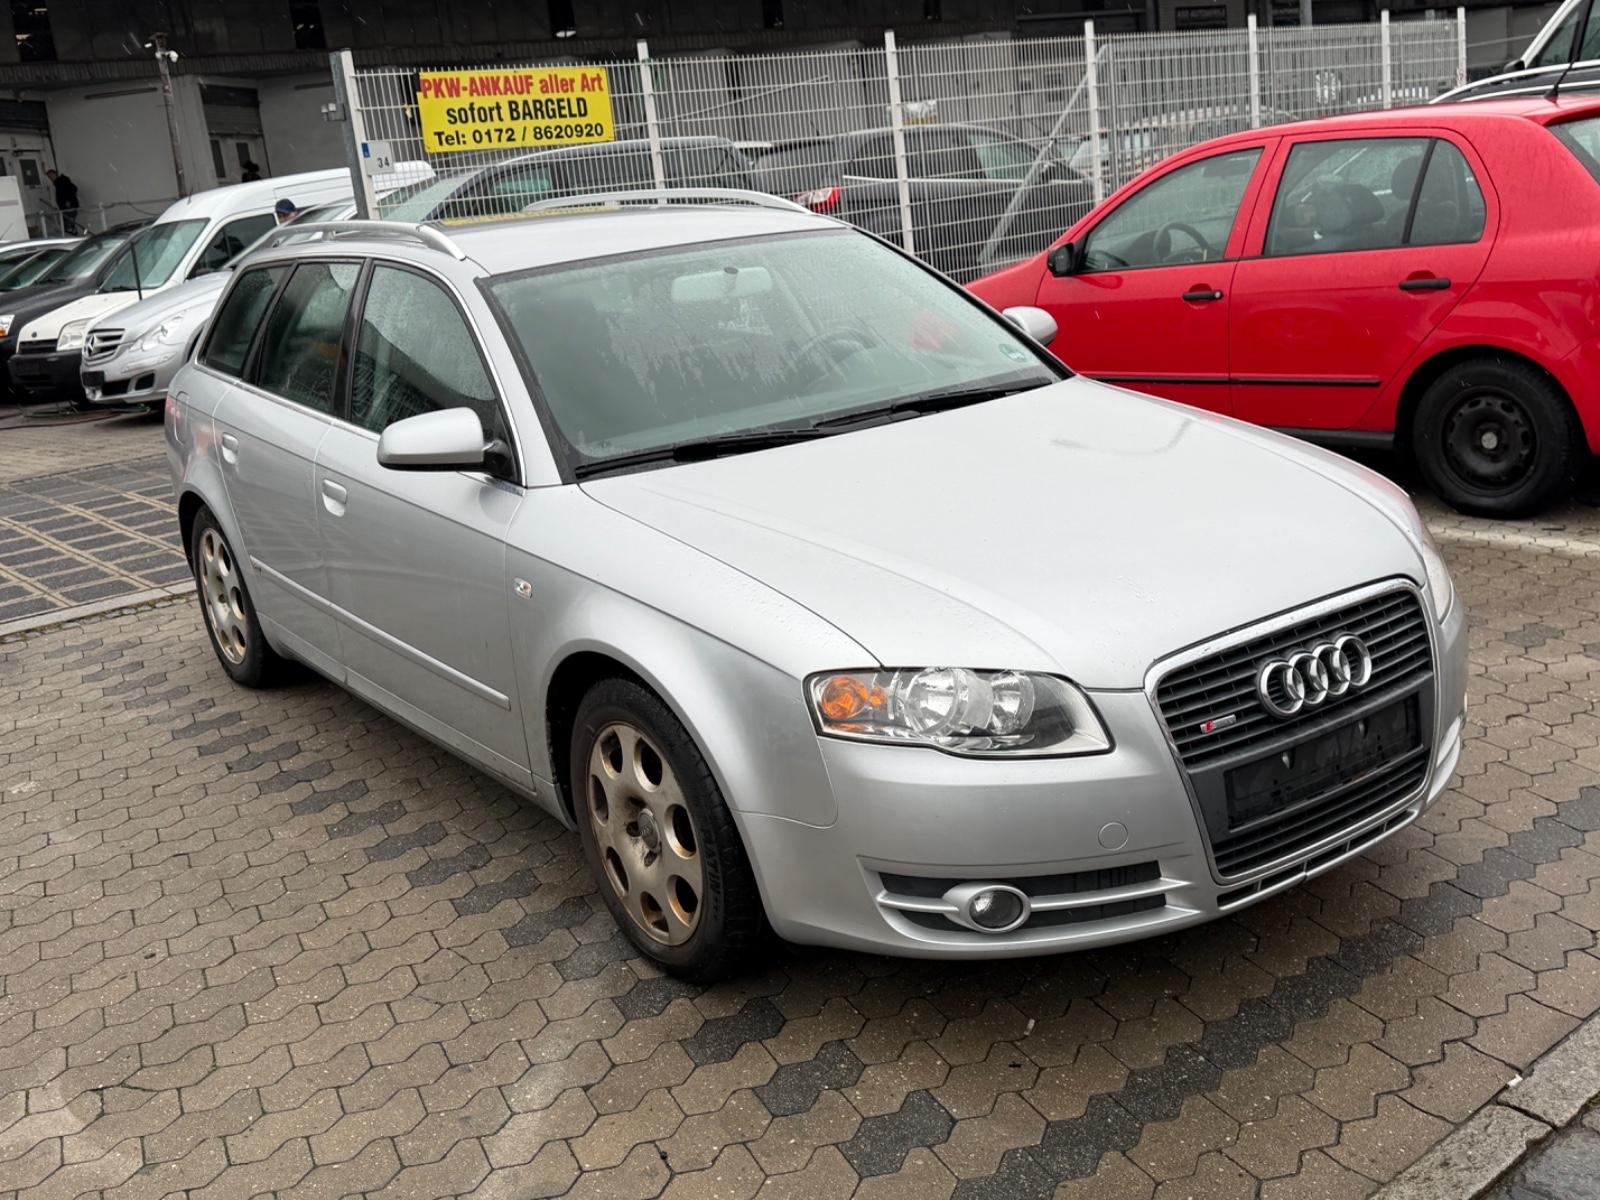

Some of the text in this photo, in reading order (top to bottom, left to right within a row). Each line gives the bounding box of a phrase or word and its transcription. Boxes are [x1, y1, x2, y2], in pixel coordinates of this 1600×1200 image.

[421, 72, 604, 98] PKW-ANKAUF aller Art
[446, 97, 588, 124] sofort BARGELD
[434, 123, 604, 147] Tel: 0172 / 8620920
[377, 156, 390, 168] 34
